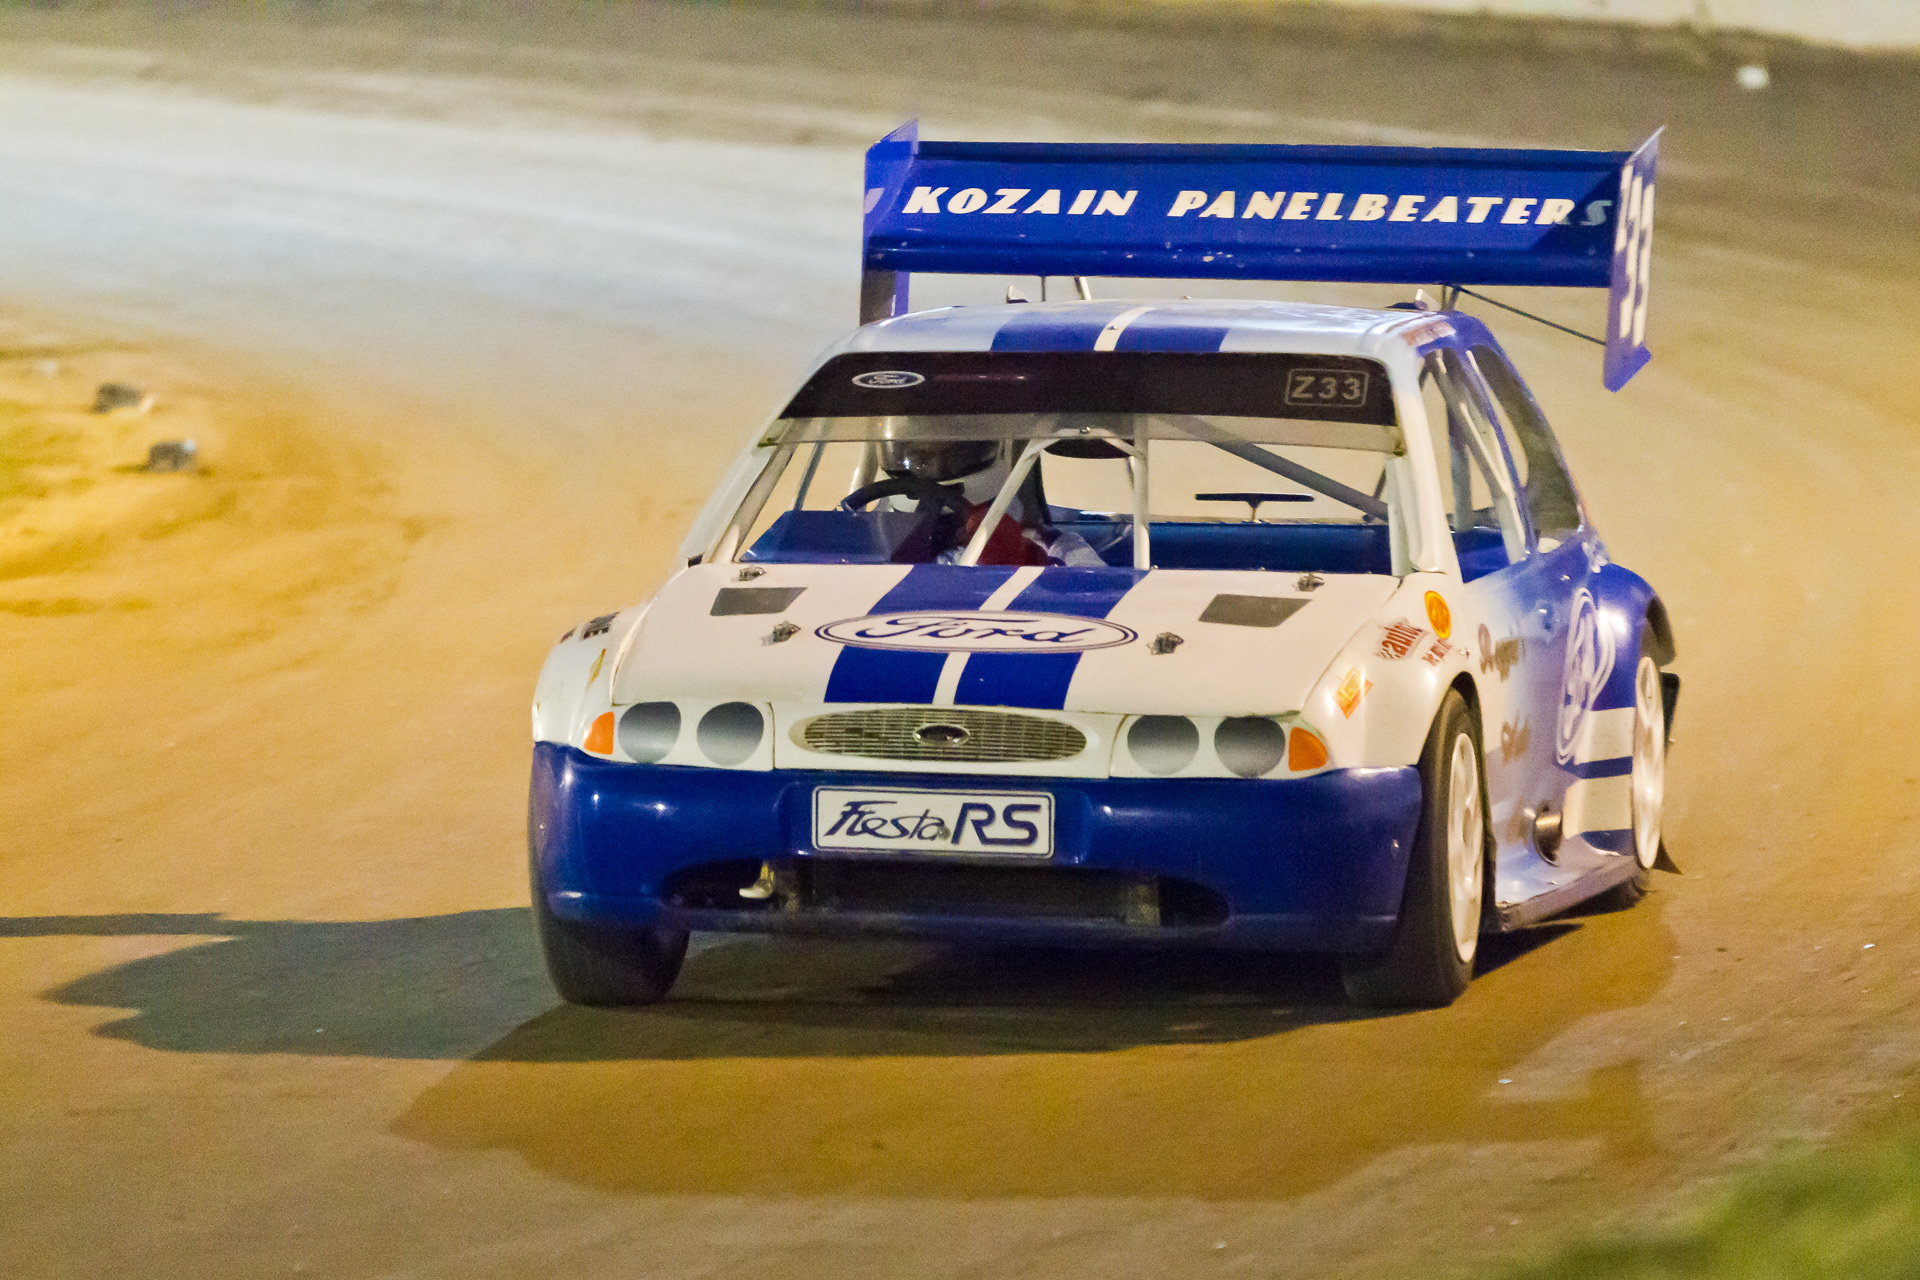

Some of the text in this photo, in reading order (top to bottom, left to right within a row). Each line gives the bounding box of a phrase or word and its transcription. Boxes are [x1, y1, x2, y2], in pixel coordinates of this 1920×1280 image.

[901, 186, 1613, 226] KOZAIN PANELBEATERS
[1291, 376, 1360, 400] Z33
[855, 616, 1096, 644] Ford
[951, 802, 1042, 847] RS
